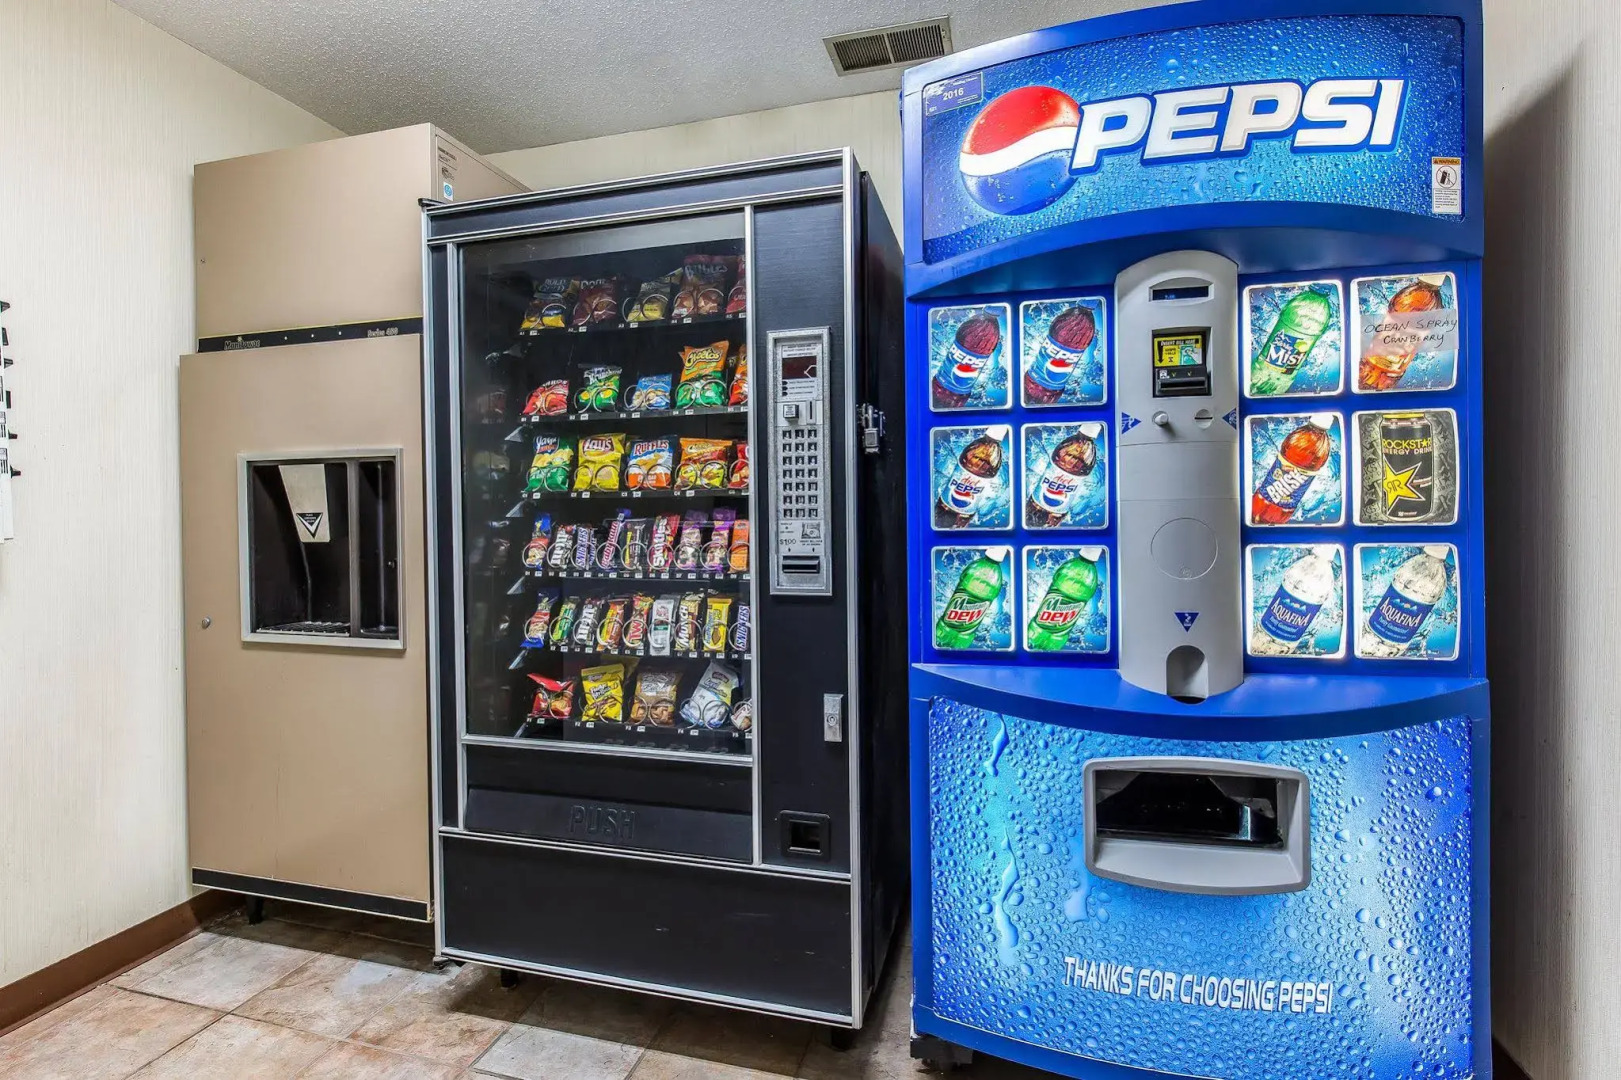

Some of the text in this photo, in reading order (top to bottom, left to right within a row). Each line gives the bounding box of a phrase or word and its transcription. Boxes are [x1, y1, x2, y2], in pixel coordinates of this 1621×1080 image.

[942, 87, 964, 100] 2016
[1072, 79, 1405, 169] PEPSI
[1364, 317, 1457, 333] OCEAN SPRAY
[1383, 334, 1445, 349] CRANBERRY
[1265, 343, 1306, 366] Mist
[634, 440, 669, 455] RUFFLES
[950, 479, 985, 494] PEPSI
[1042, 477, 1078, 493] PEPSI
[1266, 468, 1309, 504] BRISK
[1271, 597, 1311, 627] AQUAFINA
[1380, 597, 1422, 627] AQUAFINA
[569, 805, 635, 839] PUSH
[1063, 956, 1334, 1014] THANKS FOR CHOOSING PEPSI
